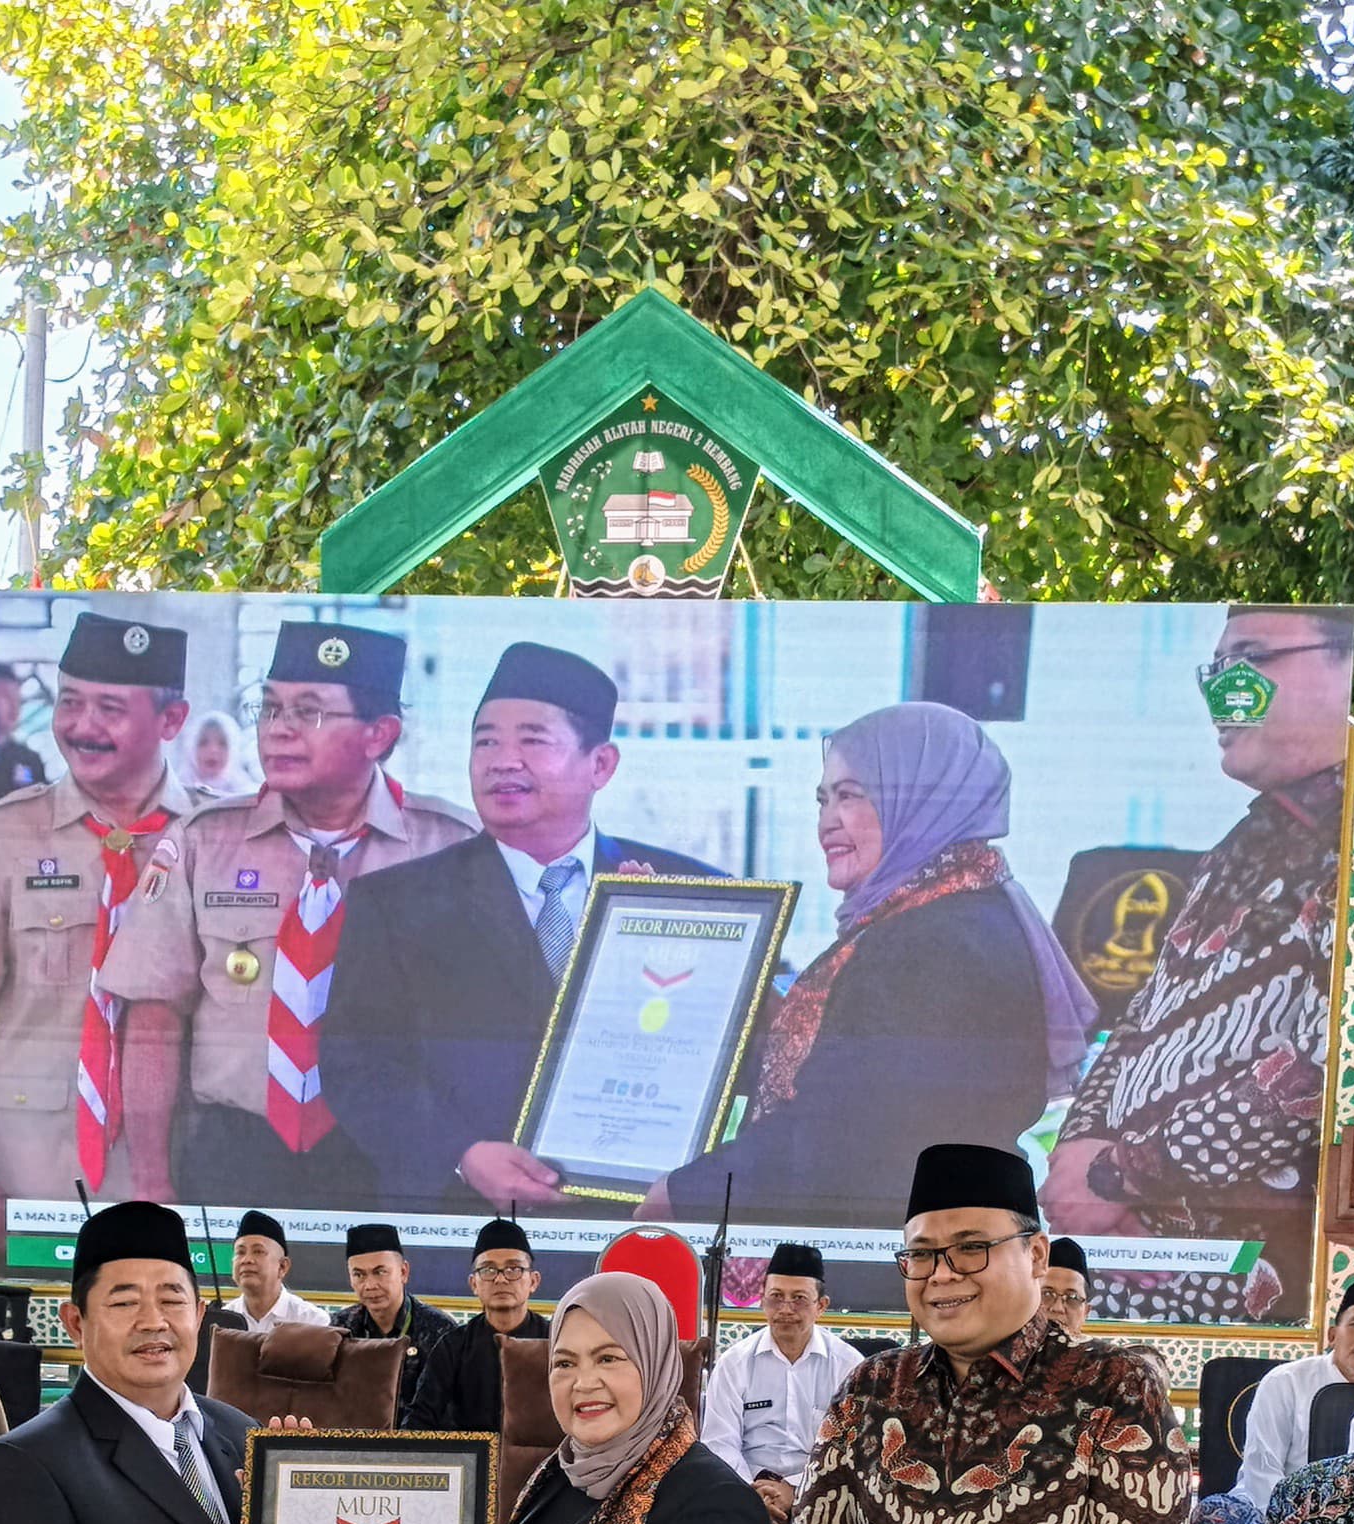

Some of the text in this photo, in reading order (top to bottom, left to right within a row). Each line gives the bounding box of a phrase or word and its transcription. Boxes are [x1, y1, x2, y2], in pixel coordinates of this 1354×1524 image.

[555, 420, 743, 493] MADRASAH ALIYAH NEGERI 2 REMBANG
[665, 921, 744, 939] INDONESIA
[13, 1211, 23, 1221] A
[25, 1212, 56, 1222] MAN
[59, 1212, 67, 1223] 2
[288, 1221, 332, 1233] MILAD
[397, 1226, 450, 1236] MBANG
[525, 1230, 574, 1241] ERAJUT
[802, 1240, 875, 1251] KEJAYAAN
[1083, 1248, 1137, 1259] ERMUTU
[1141, 1249, 1173, 1260] DAN
[1177, 1251, 1230, 1263] MENDU
[292, 1473, 448, 1488] REKOR INDONESIA
[337, 1496, 402, 1516] MURI
